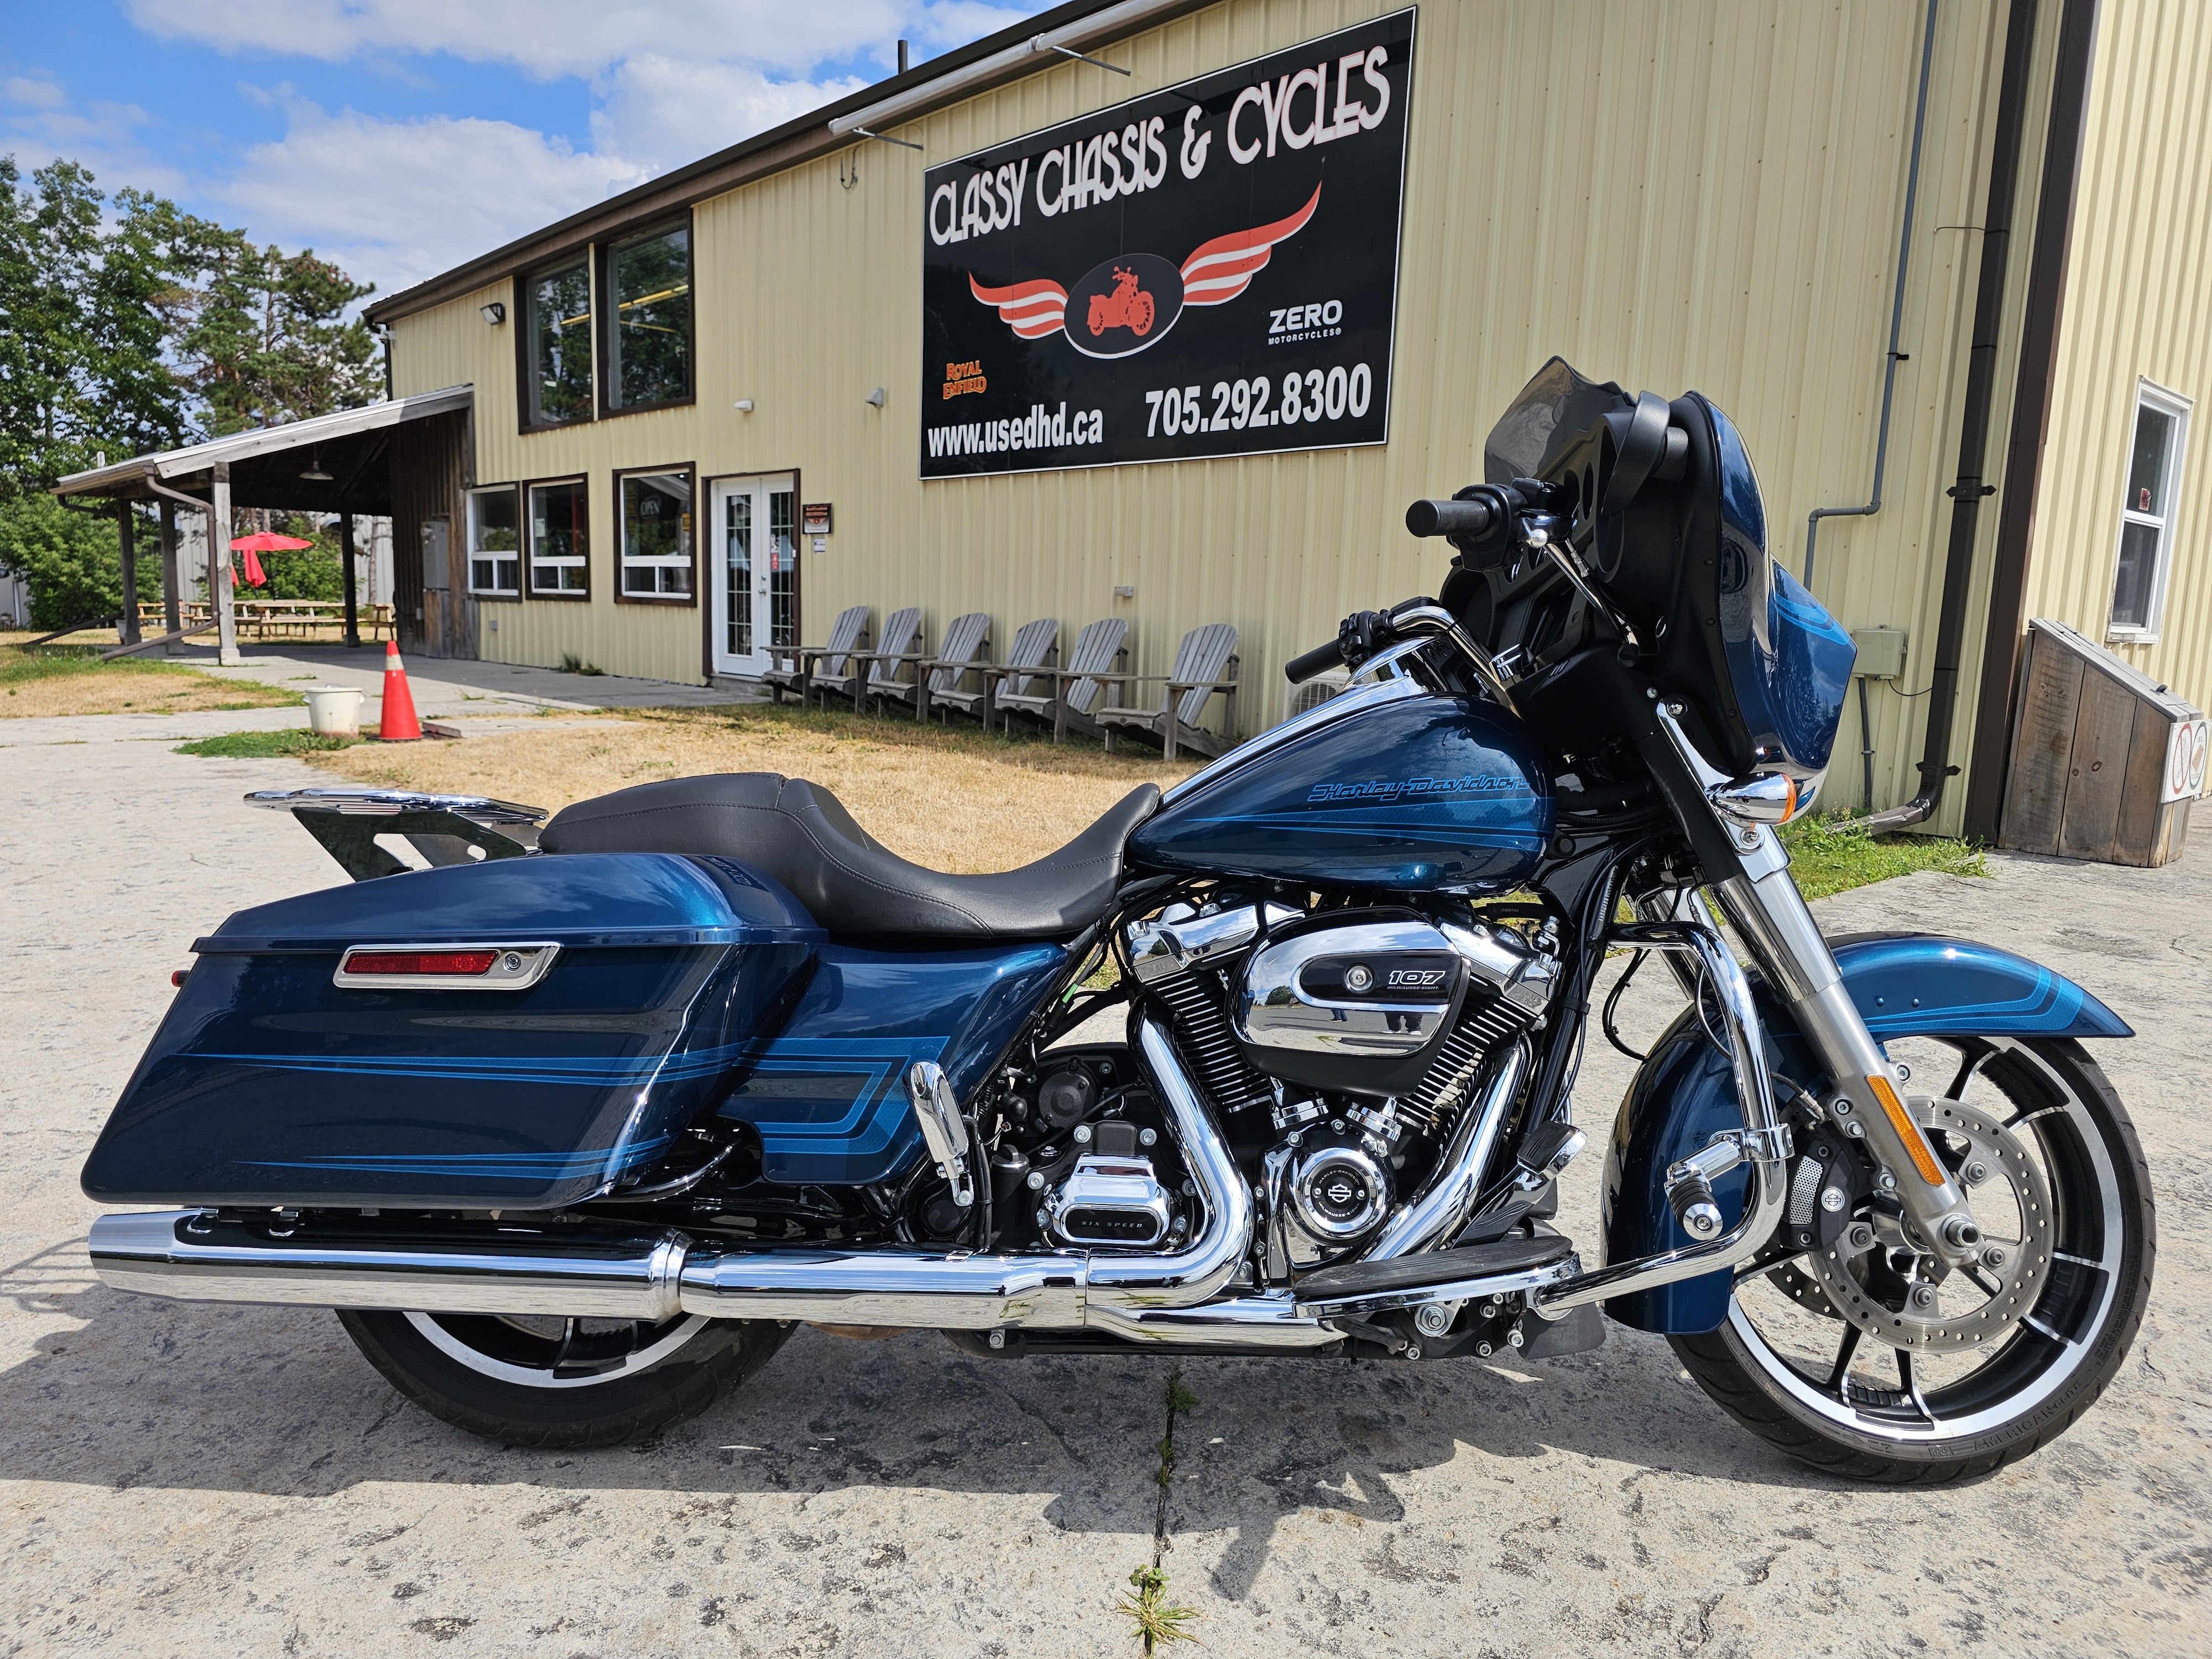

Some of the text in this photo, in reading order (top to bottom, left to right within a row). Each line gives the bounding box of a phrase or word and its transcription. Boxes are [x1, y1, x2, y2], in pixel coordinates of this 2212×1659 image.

[930, 46, 1390, 246] CLASSY CHASSIS & CYCLES
[1269, 300, 1343, 334] ZERO
[946, 360, 983, 381] ROYAL
[943, 376, 987, 400] ENFIELD
[1145, 363, 1371, 437] 705.292.8300
[927, 401, 1103, 457] www.usedhd.ca
[640, 501, 660, 516] OPEN
[1307, 774, 1530, 801] Harley-Davidson
[1388, 971, 1446, 985] 107
[1318, 1170, 1360, 1186] HARLEY-DAVIDSON
